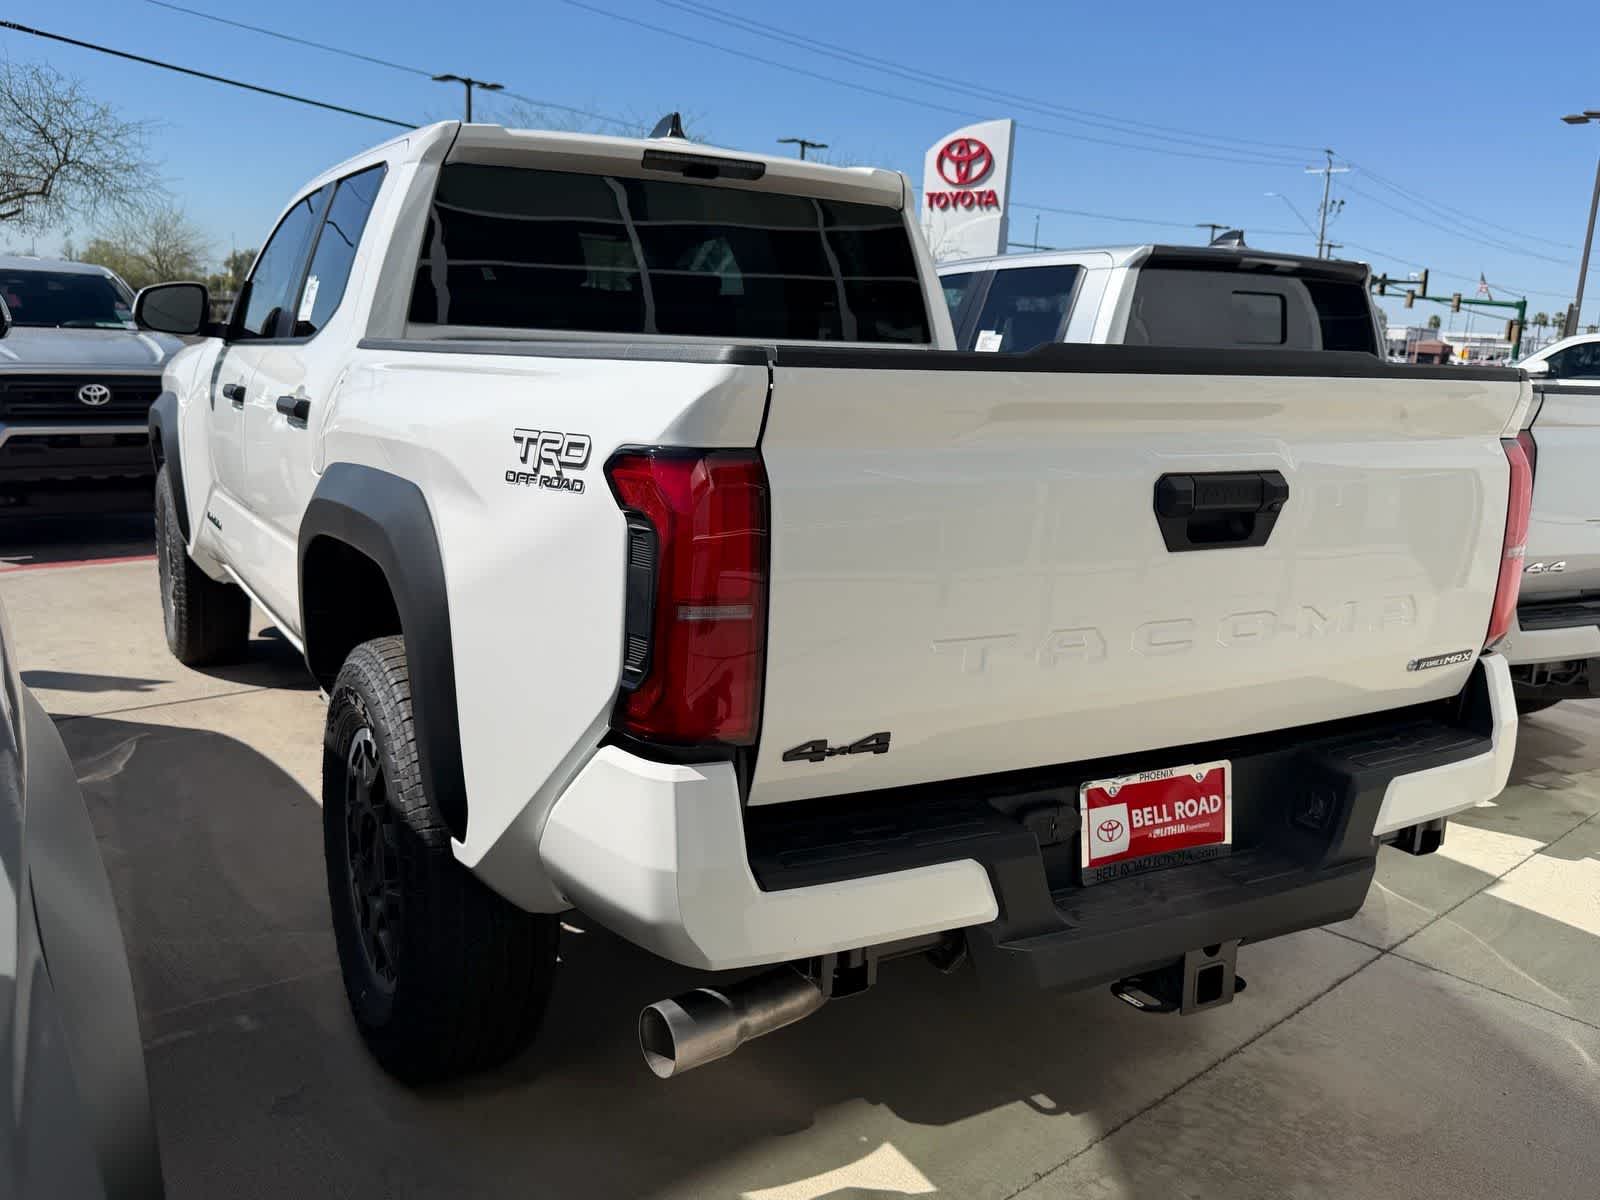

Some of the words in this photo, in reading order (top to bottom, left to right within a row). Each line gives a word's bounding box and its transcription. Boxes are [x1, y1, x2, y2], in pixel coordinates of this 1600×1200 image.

[926, 190, 1000, 210] TOYOTA
[513, 427, 592, 477] TRD
[505, 470, 538, 485] OFF
[539, 475, 585, 494] ROAD
[930, 592, 1418, 674] TACOMA
[1443, 652, 1471, 665] MAX
[1139, 769, 1174, 781] PHOENIX
[1131, 804, 1172, 828] BELL
[1174, 794, 1221, 820] ROAD
